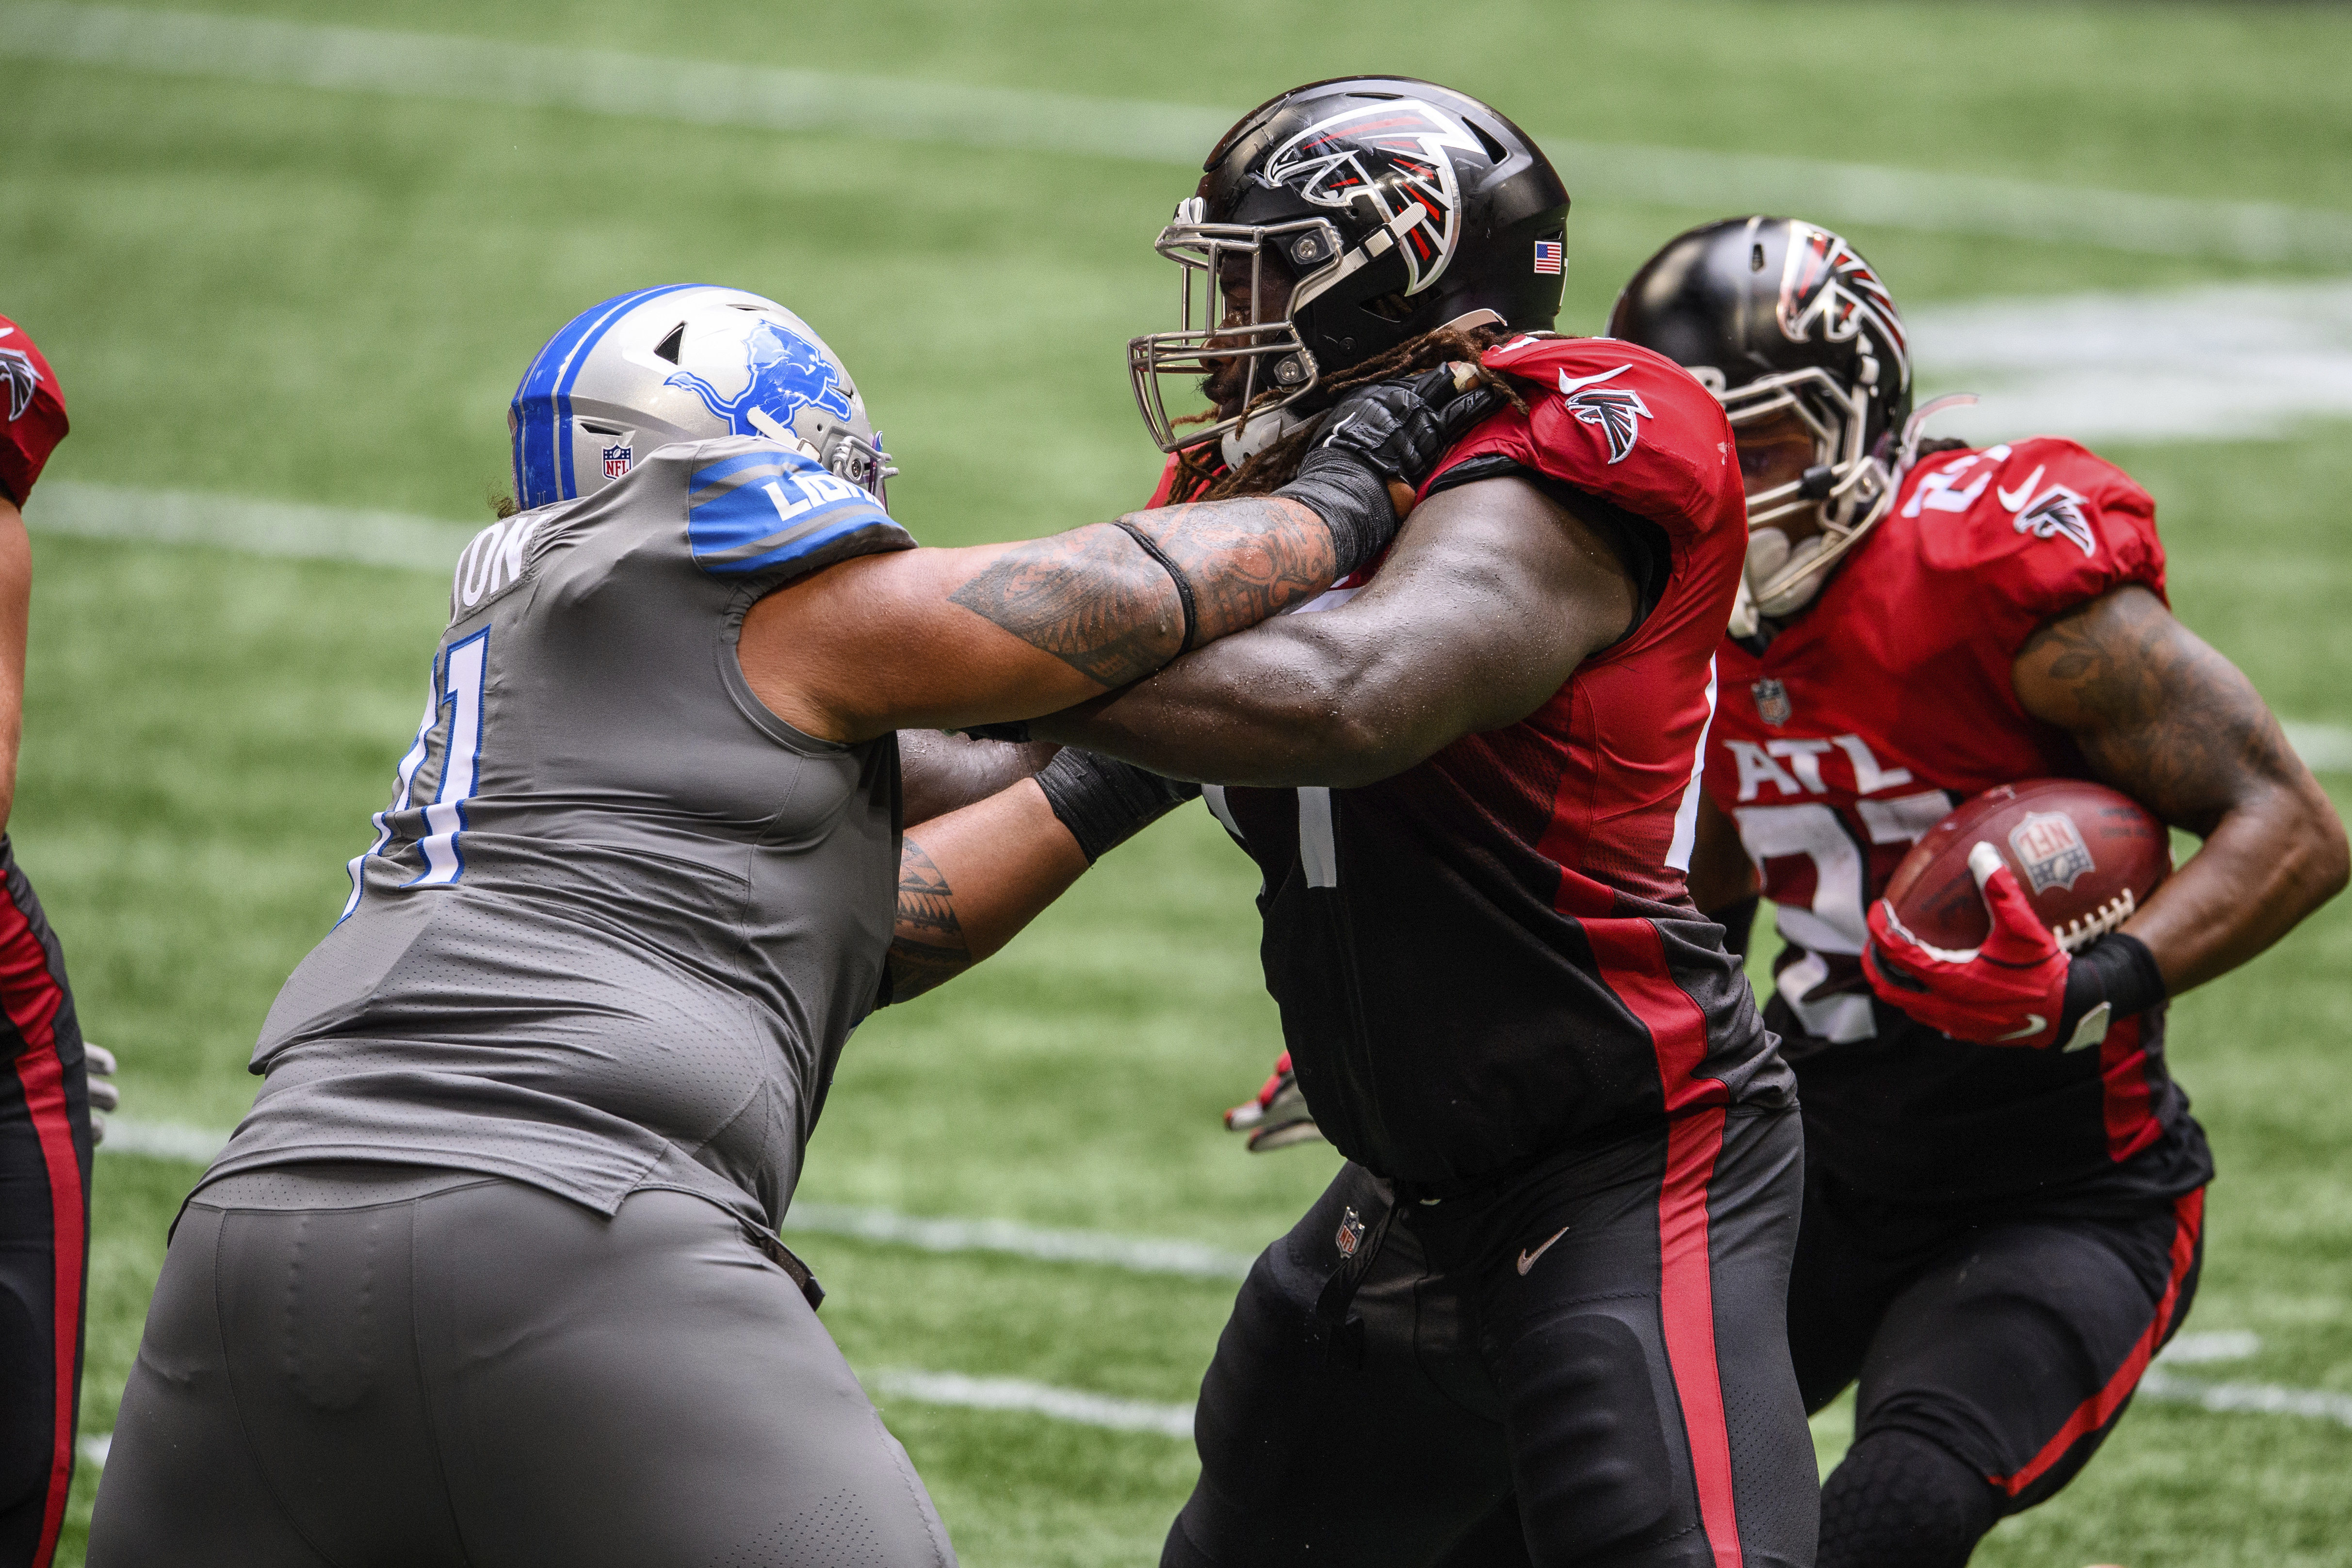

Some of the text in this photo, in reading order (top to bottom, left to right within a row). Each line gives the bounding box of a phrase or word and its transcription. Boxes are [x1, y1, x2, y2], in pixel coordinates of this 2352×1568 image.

[606, 460, 629, 477] NFL
[762, 474, 887, 522] LION
[452, 513, 553, 624] ON
[1723, 733, 1913, 802] ATL
[2019, 821, 2076, 861] NFL
[1732, 789, 1954, 1045] 2
[1339, 1227, 1356, 1253] NFL
